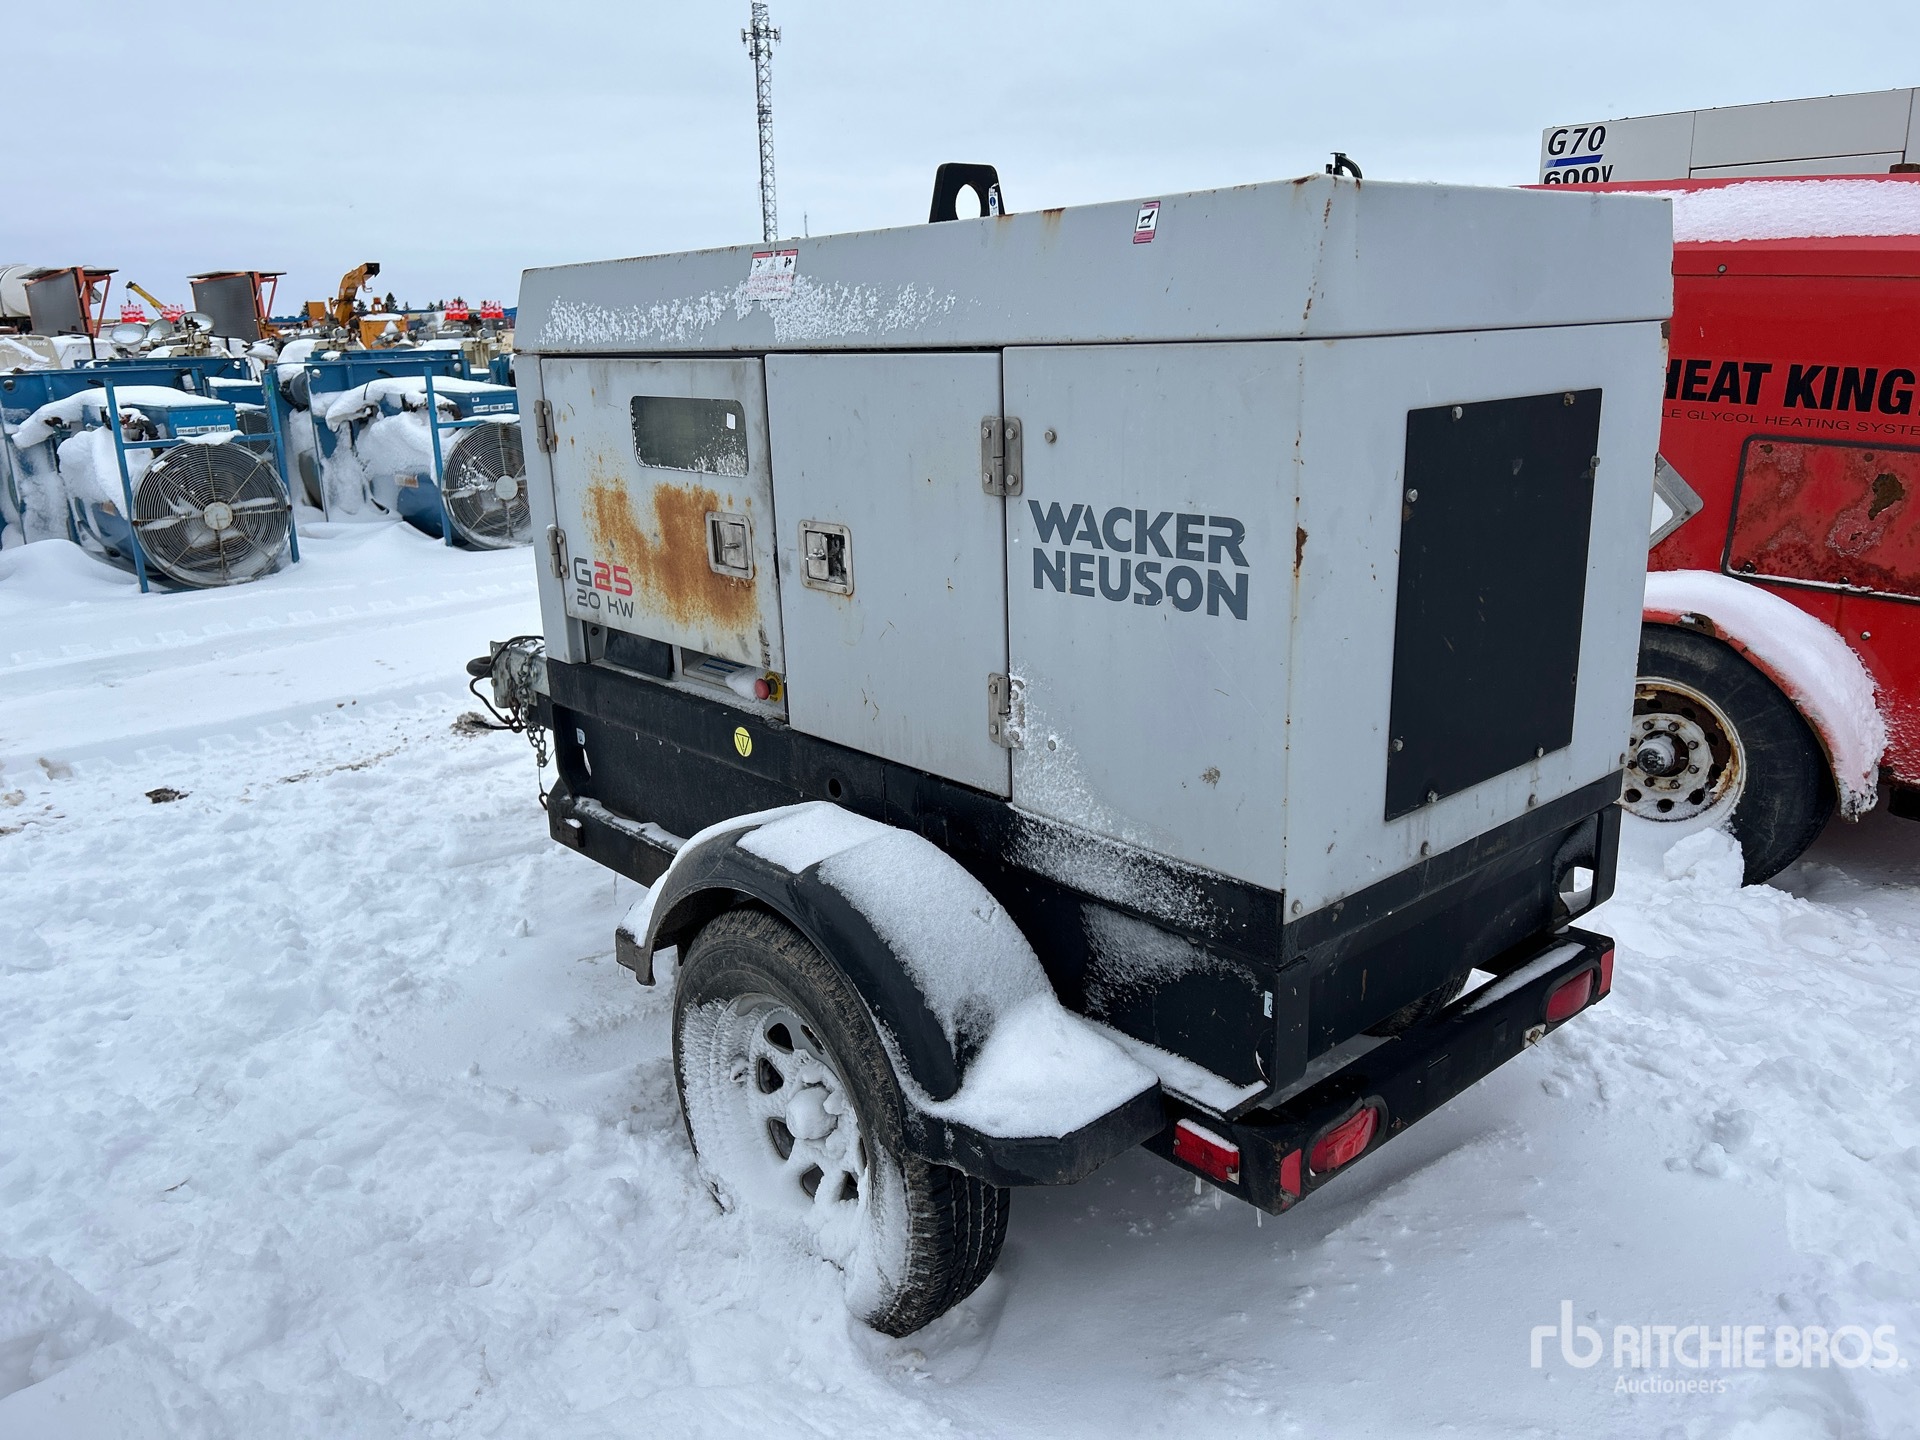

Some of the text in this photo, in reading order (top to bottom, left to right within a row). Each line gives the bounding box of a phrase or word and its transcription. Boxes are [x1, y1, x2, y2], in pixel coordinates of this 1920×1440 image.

[1547, 125, 1607, 156] G70
[1543, 164, 1614, 185] 600V
[1783, 363, 1916, 416] KING
[1686, 409, 1759, 424] GLYCOL
[1764, 415, 1851, 431] HEATING
[1027, 499, 1250, 568] WACKER
[573, 556, 633, 597] G25
[1032, 547, 1249, 621] NEUSON
[576, 587, 601, 610] 20
